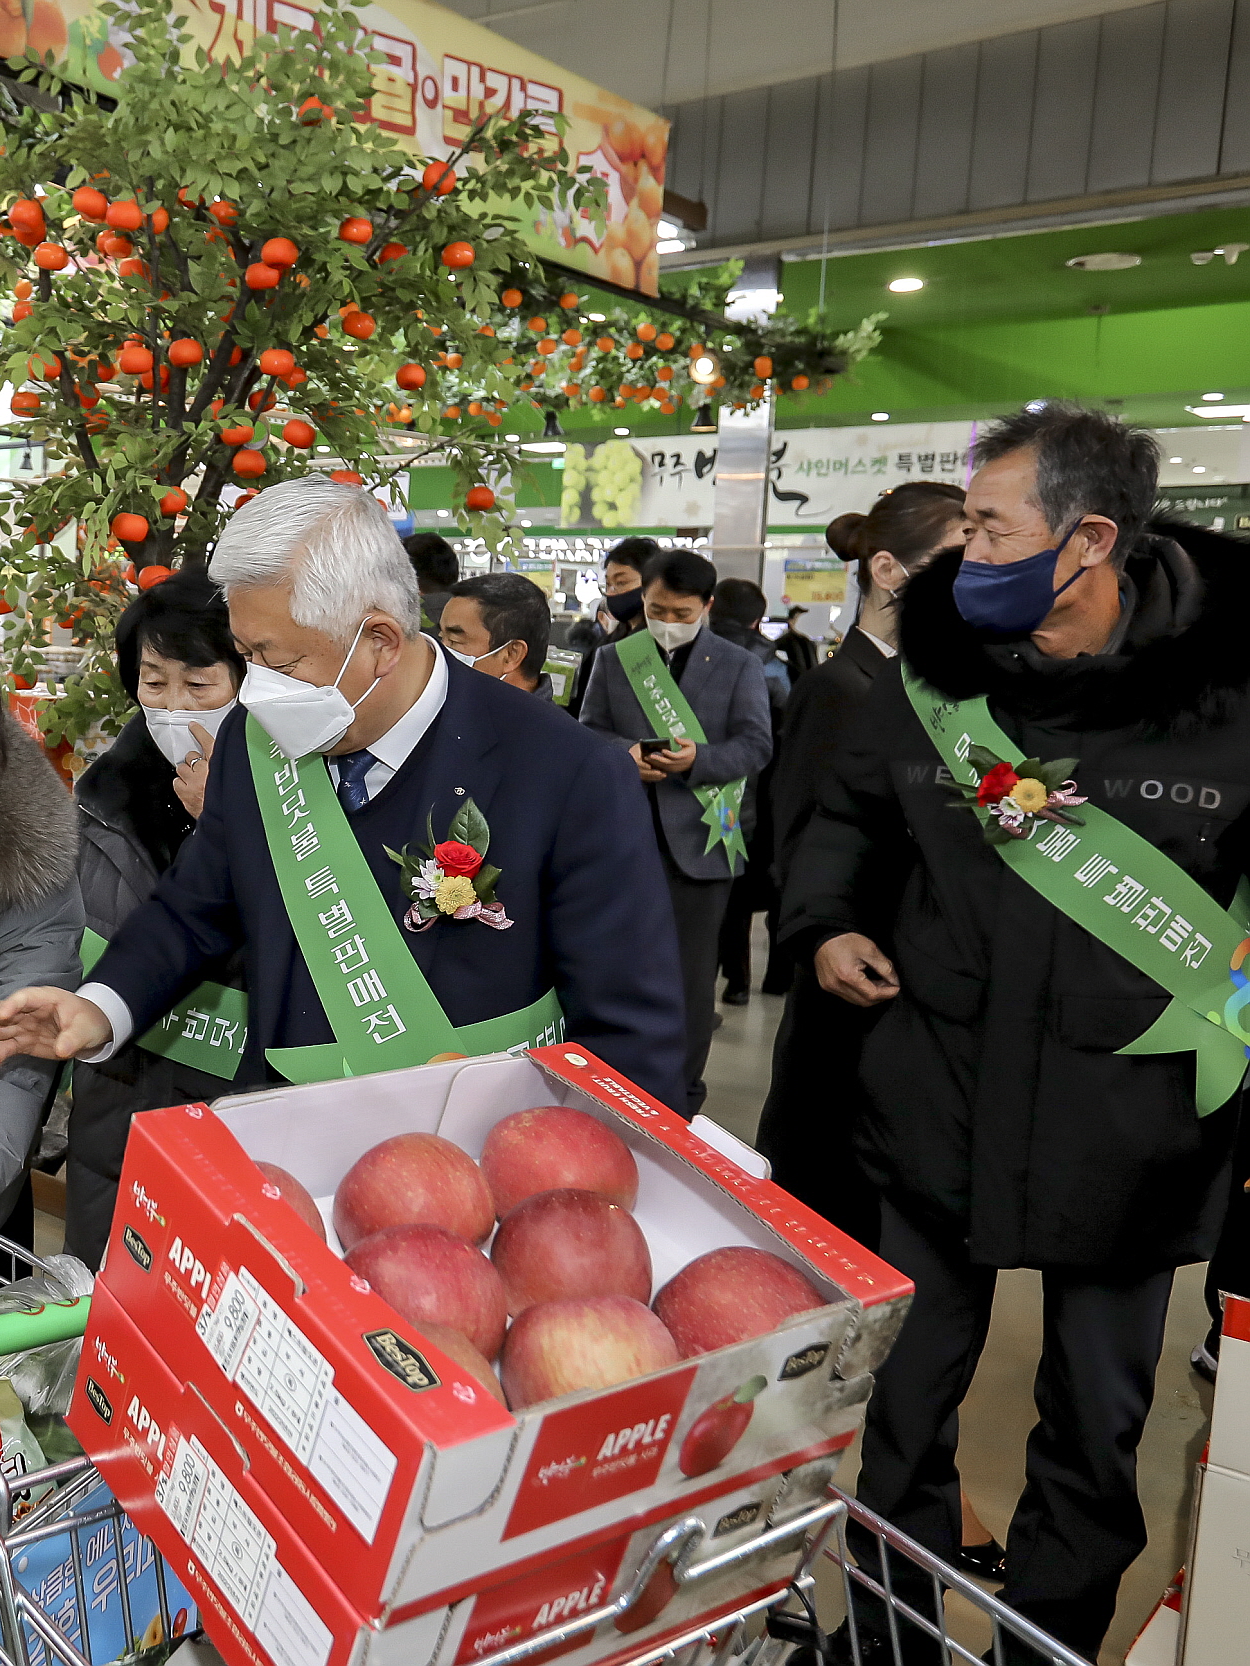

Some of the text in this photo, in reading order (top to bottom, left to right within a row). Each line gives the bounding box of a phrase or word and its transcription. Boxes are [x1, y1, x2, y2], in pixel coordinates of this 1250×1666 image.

[1103, 779, 1221, 810] WOOD
[1073, 853, 1213, 970] 특별판매전
[304, 865, 407, 1044] 특별판매전
[125, 1229, 151, 1266] BesTop
[224, 1288, 246, 1332] 9,800
[376, 1332, 431, 1387] BesTop
[88, 1379, 113, 1421] BesTop
[597, 1413, 671, 1461] APPLE
[178, 1453, 197, 1495] 9,800
[531, 1581, 606, 1629] APPLE
